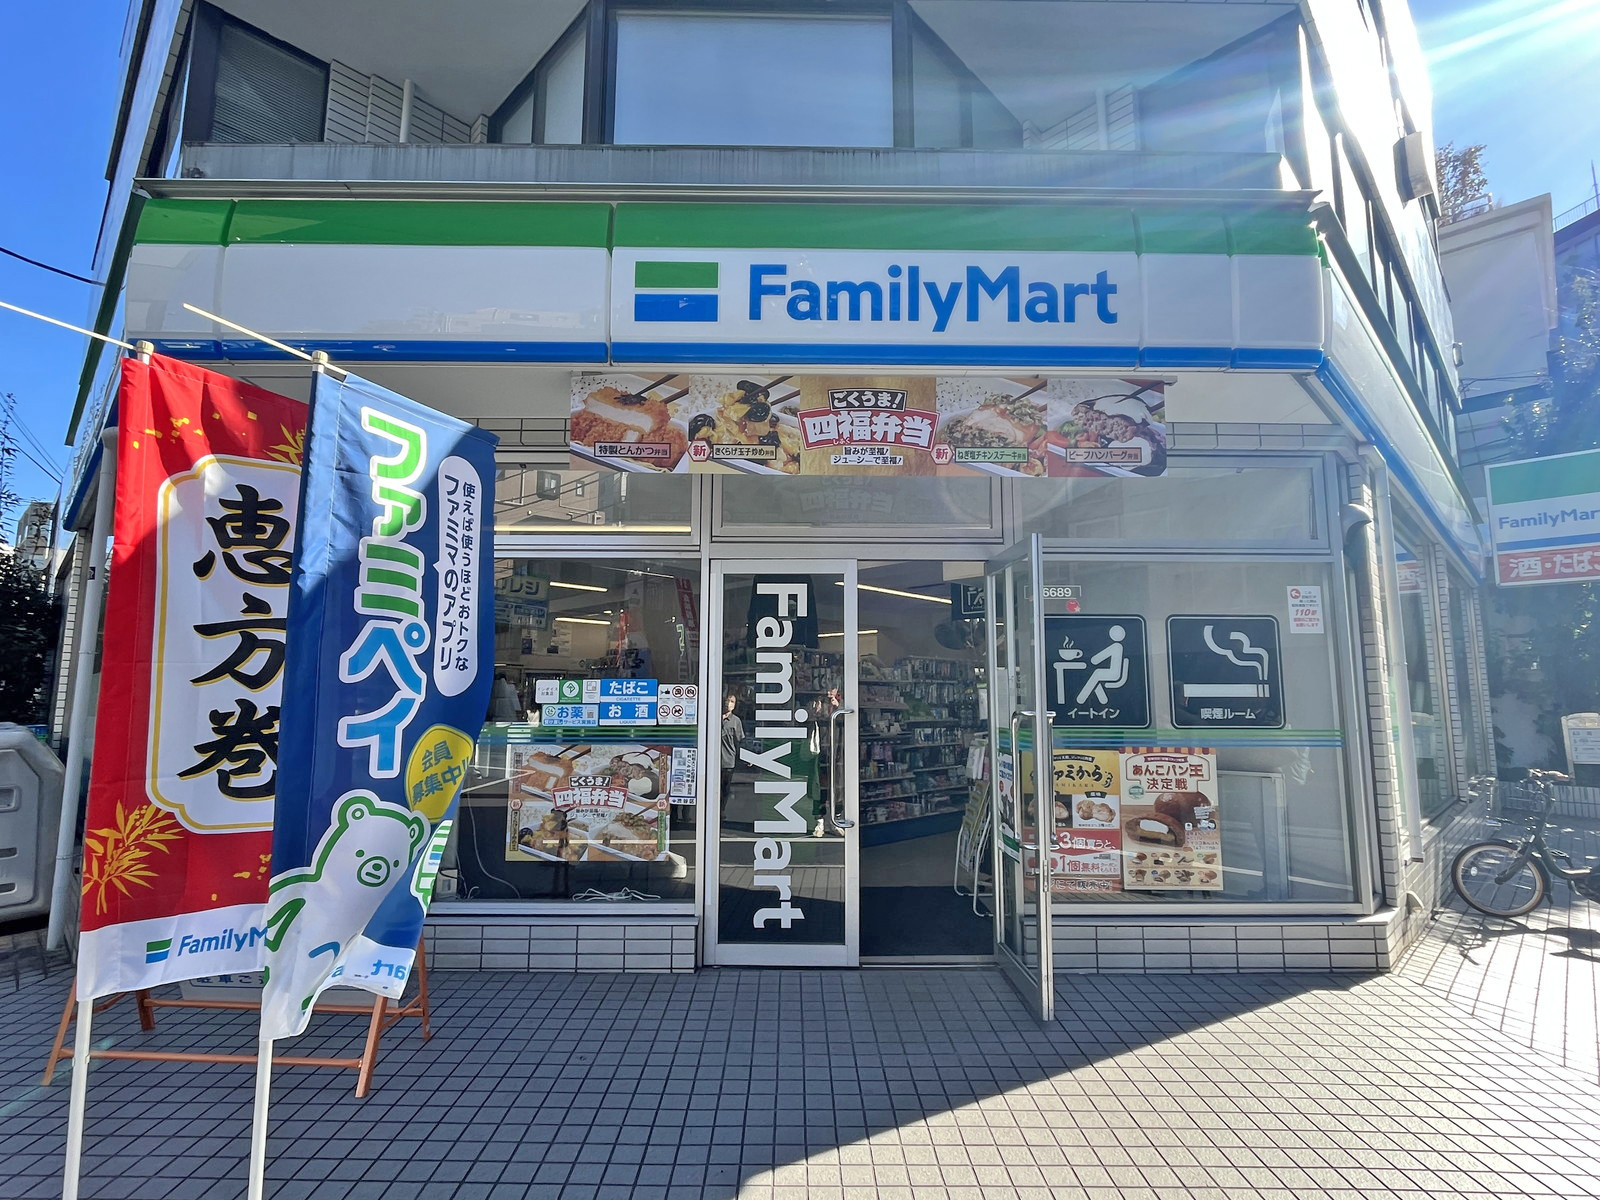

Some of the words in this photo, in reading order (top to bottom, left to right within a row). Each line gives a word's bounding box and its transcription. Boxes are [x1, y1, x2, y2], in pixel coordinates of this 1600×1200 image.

[749, 264, 1118, 333] FamilyMart
[833, 391, 903, 409] ごくうま!
[803, 411, 932, 447] 四福弁当
[599, 445, 668, 456] 特製とんかつ弁当
[693, 445, 707, 457] 新
[936, 448, 949, 460] 新
[1498, 509, 1600, 530] FamilyMar
[440, 474, 460, 671] ファミマのアプリ
[455, 481, 476, 672] 使えば使うほどおトクな
[339, 406, 431, 779] ファミペイ
[178, 483, 292, 800] 恵方巻
[609, 681, 649, 695] たばこ
[557, 706, 584, 719] お薬
[608, 704, 649, 718] お酒
[1068, 708, 1121, 719] イートイン
[1200, 708, 1256, 720] 喫煙ルーム
[422, 740, 453, 772] 会員
[740, 583, 808, 929] FamilyMart
[1132, 763, 1205, 778] あんこパン王
[1147, 777, 1189, 791] 決定戦
[554, 787, 626, 808] 四福弁当
